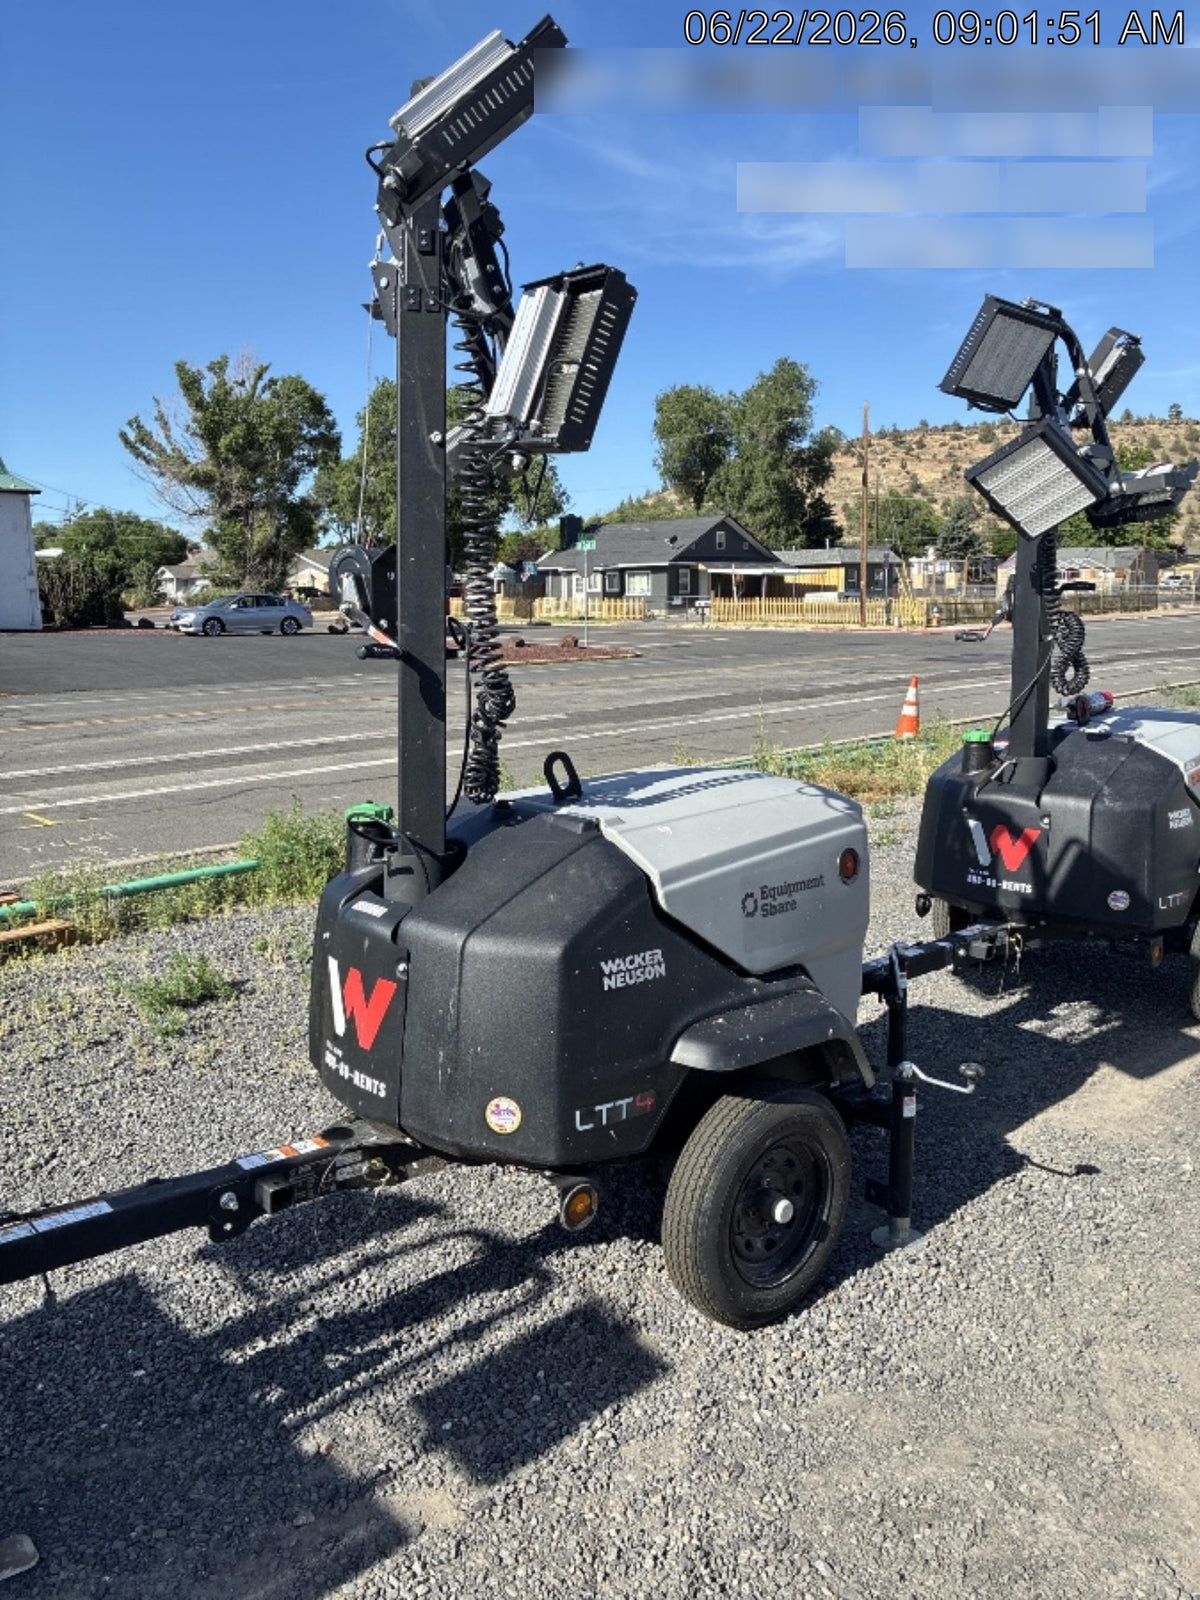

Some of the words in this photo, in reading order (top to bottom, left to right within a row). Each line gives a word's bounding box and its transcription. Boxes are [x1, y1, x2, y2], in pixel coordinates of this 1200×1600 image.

[760, 874, 825, 901] Equipment
[760, 899, 797, 918] Share
[600, 949, 664, 975] WACKER
[603, 963, 666, 991] NEUSON
